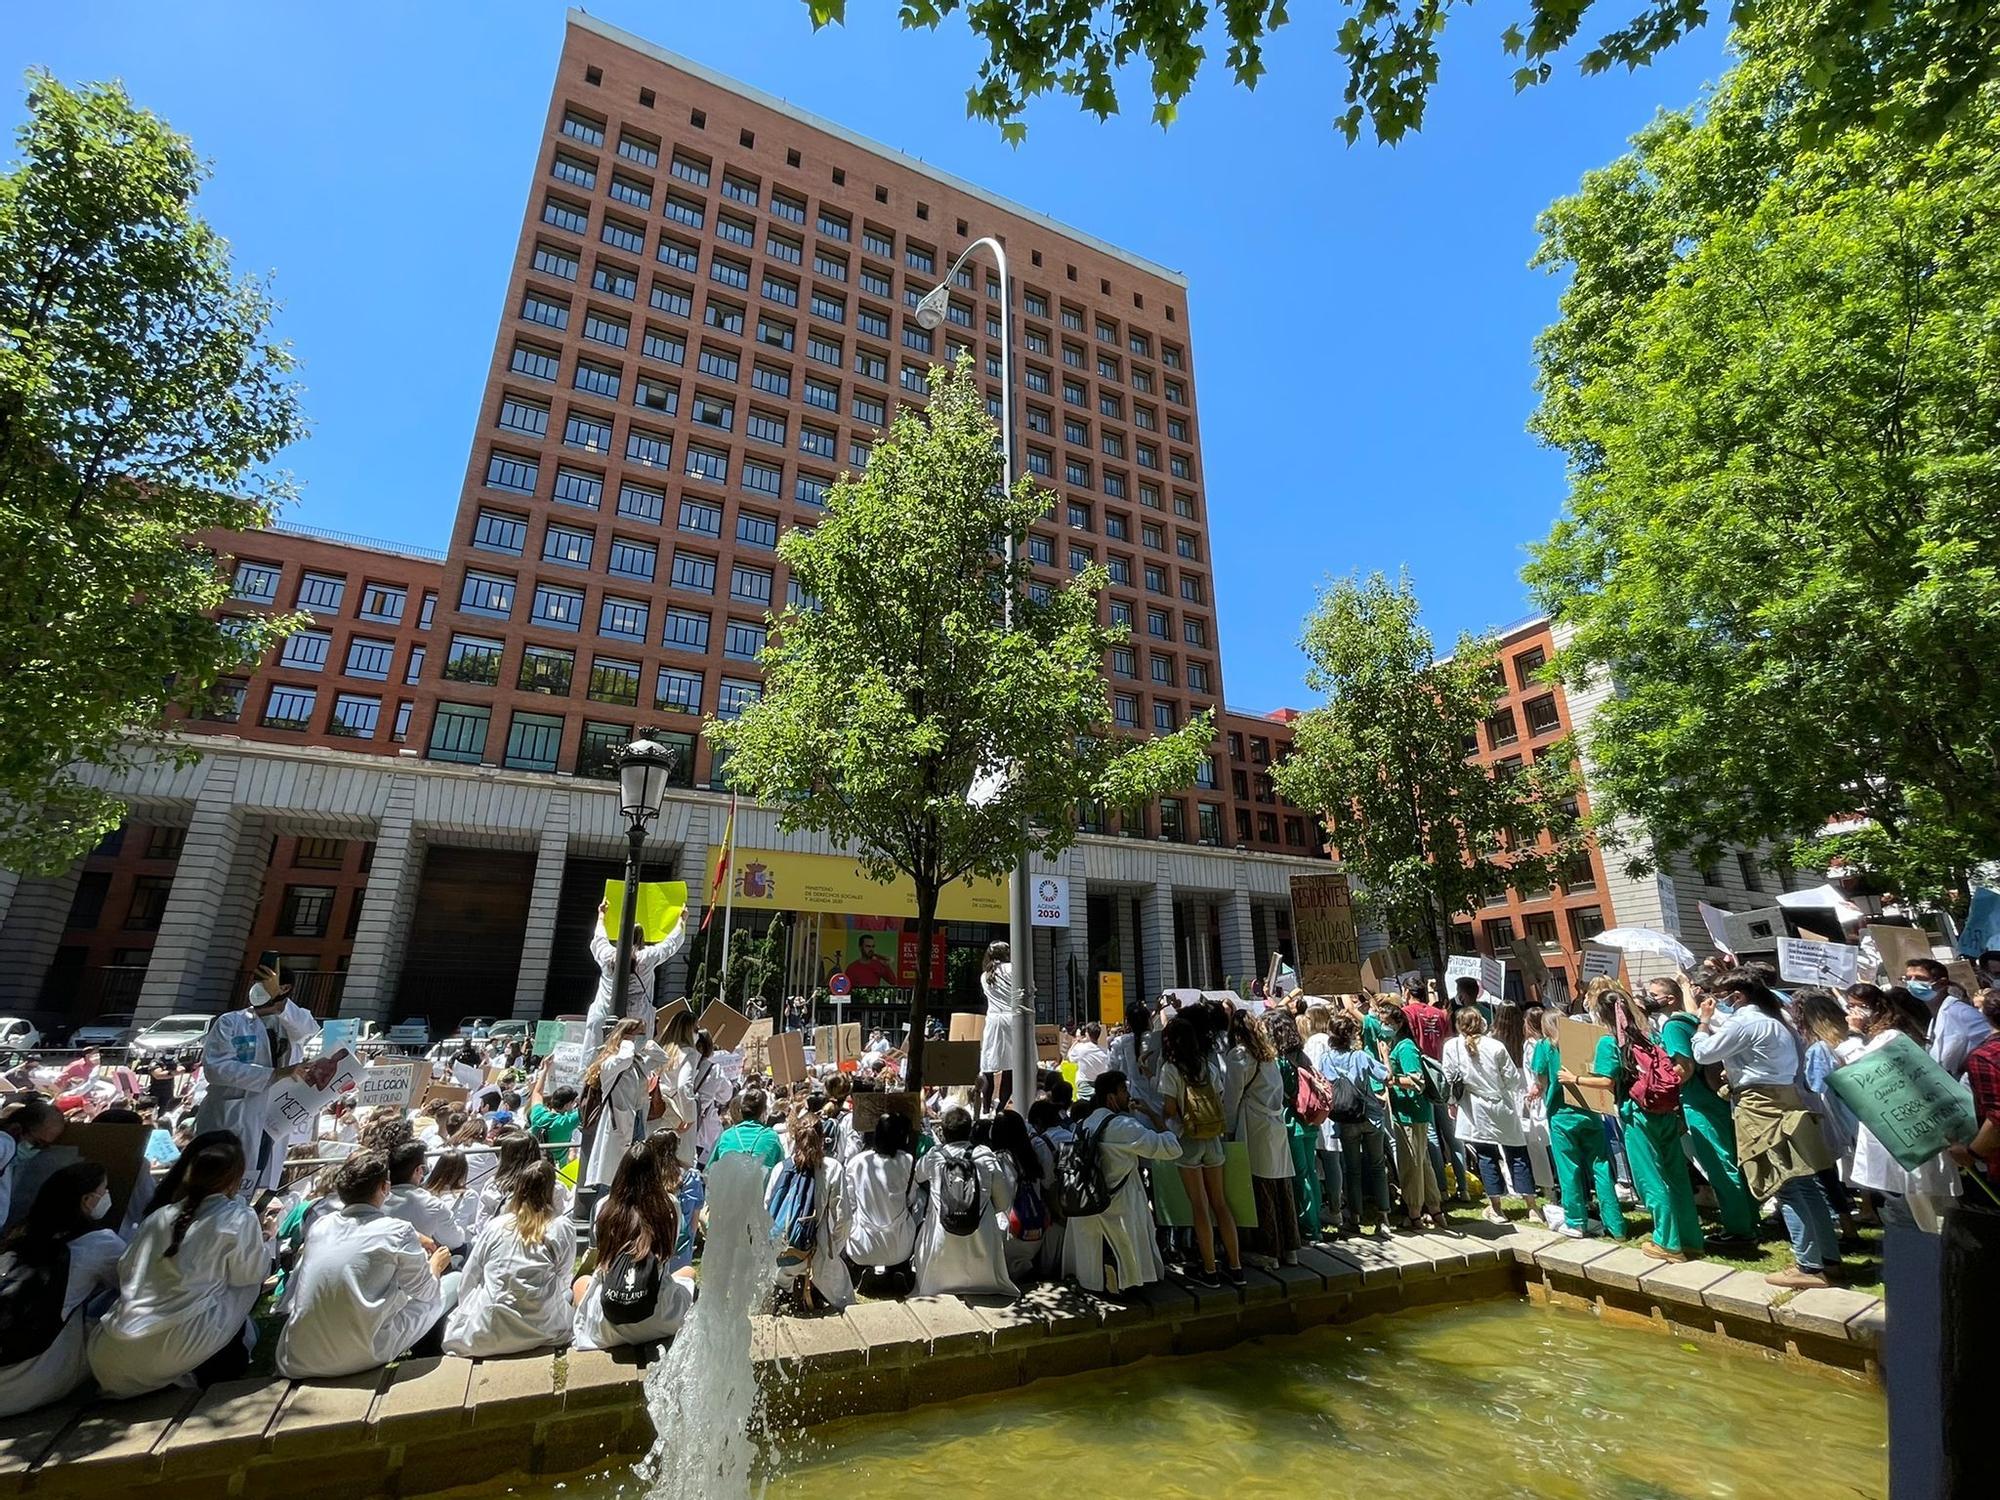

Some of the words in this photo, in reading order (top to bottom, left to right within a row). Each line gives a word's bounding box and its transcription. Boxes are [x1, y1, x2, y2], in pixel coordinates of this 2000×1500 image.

[1037, 909, 1060, 919] 2030
[1850, 1074, 1875, 1089] De
[362, 1094, 378, 1104] NOT
[379, 1093, 403, 1102] FOUND
[1891, 1099, 1926, 1122] ERROR
[1903, 1118, 1931, 1141] PLAZA
